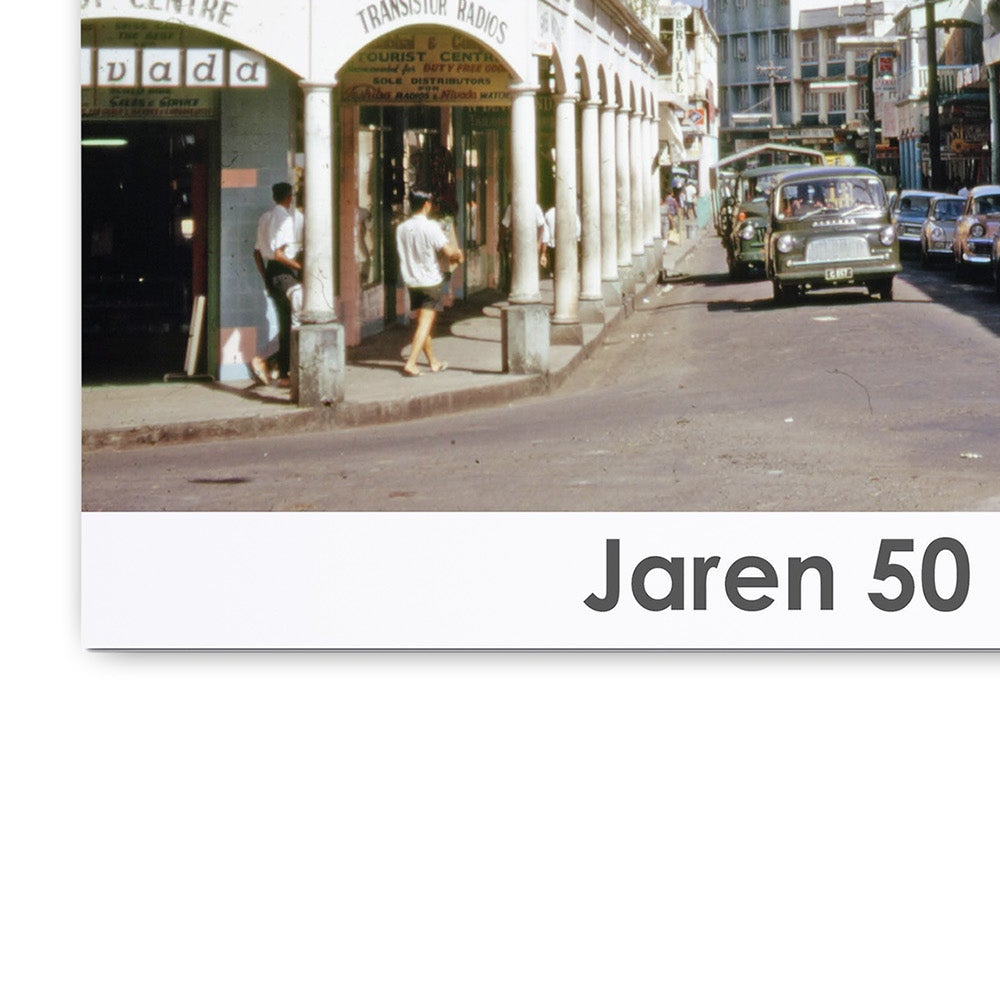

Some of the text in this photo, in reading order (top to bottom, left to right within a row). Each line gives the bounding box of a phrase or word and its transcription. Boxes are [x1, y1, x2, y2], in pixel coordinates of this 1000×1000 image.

[359, 51, 501, 63] TOURIST CENTR
[107, 54, 260, 82] vada
[373, 77, 491, 85] SOLE DISTRIBUTORS
[583, 538, 834, 612] Jaren
[867, 537, 970, 612] 50
